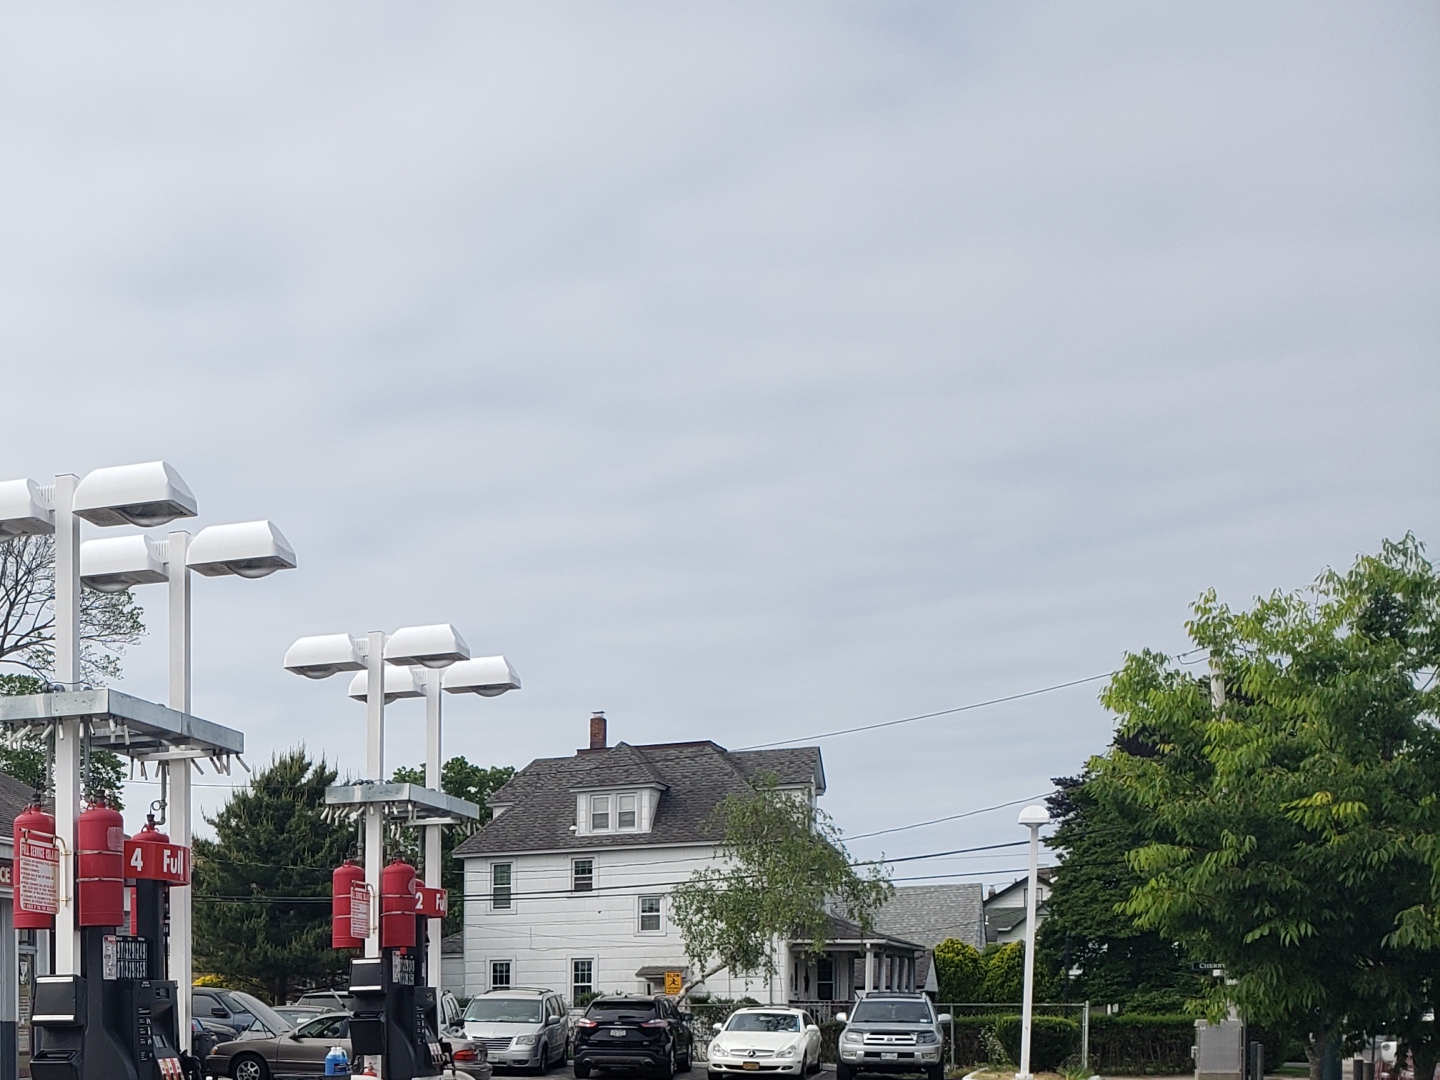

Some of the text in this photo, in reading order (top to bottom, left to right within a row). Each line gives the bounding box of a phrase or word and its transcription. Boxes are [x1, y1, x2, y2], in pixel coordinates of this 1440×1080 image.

[130, 847, 183, 875] 4 Full
[414, 891, 424, 910] 2
